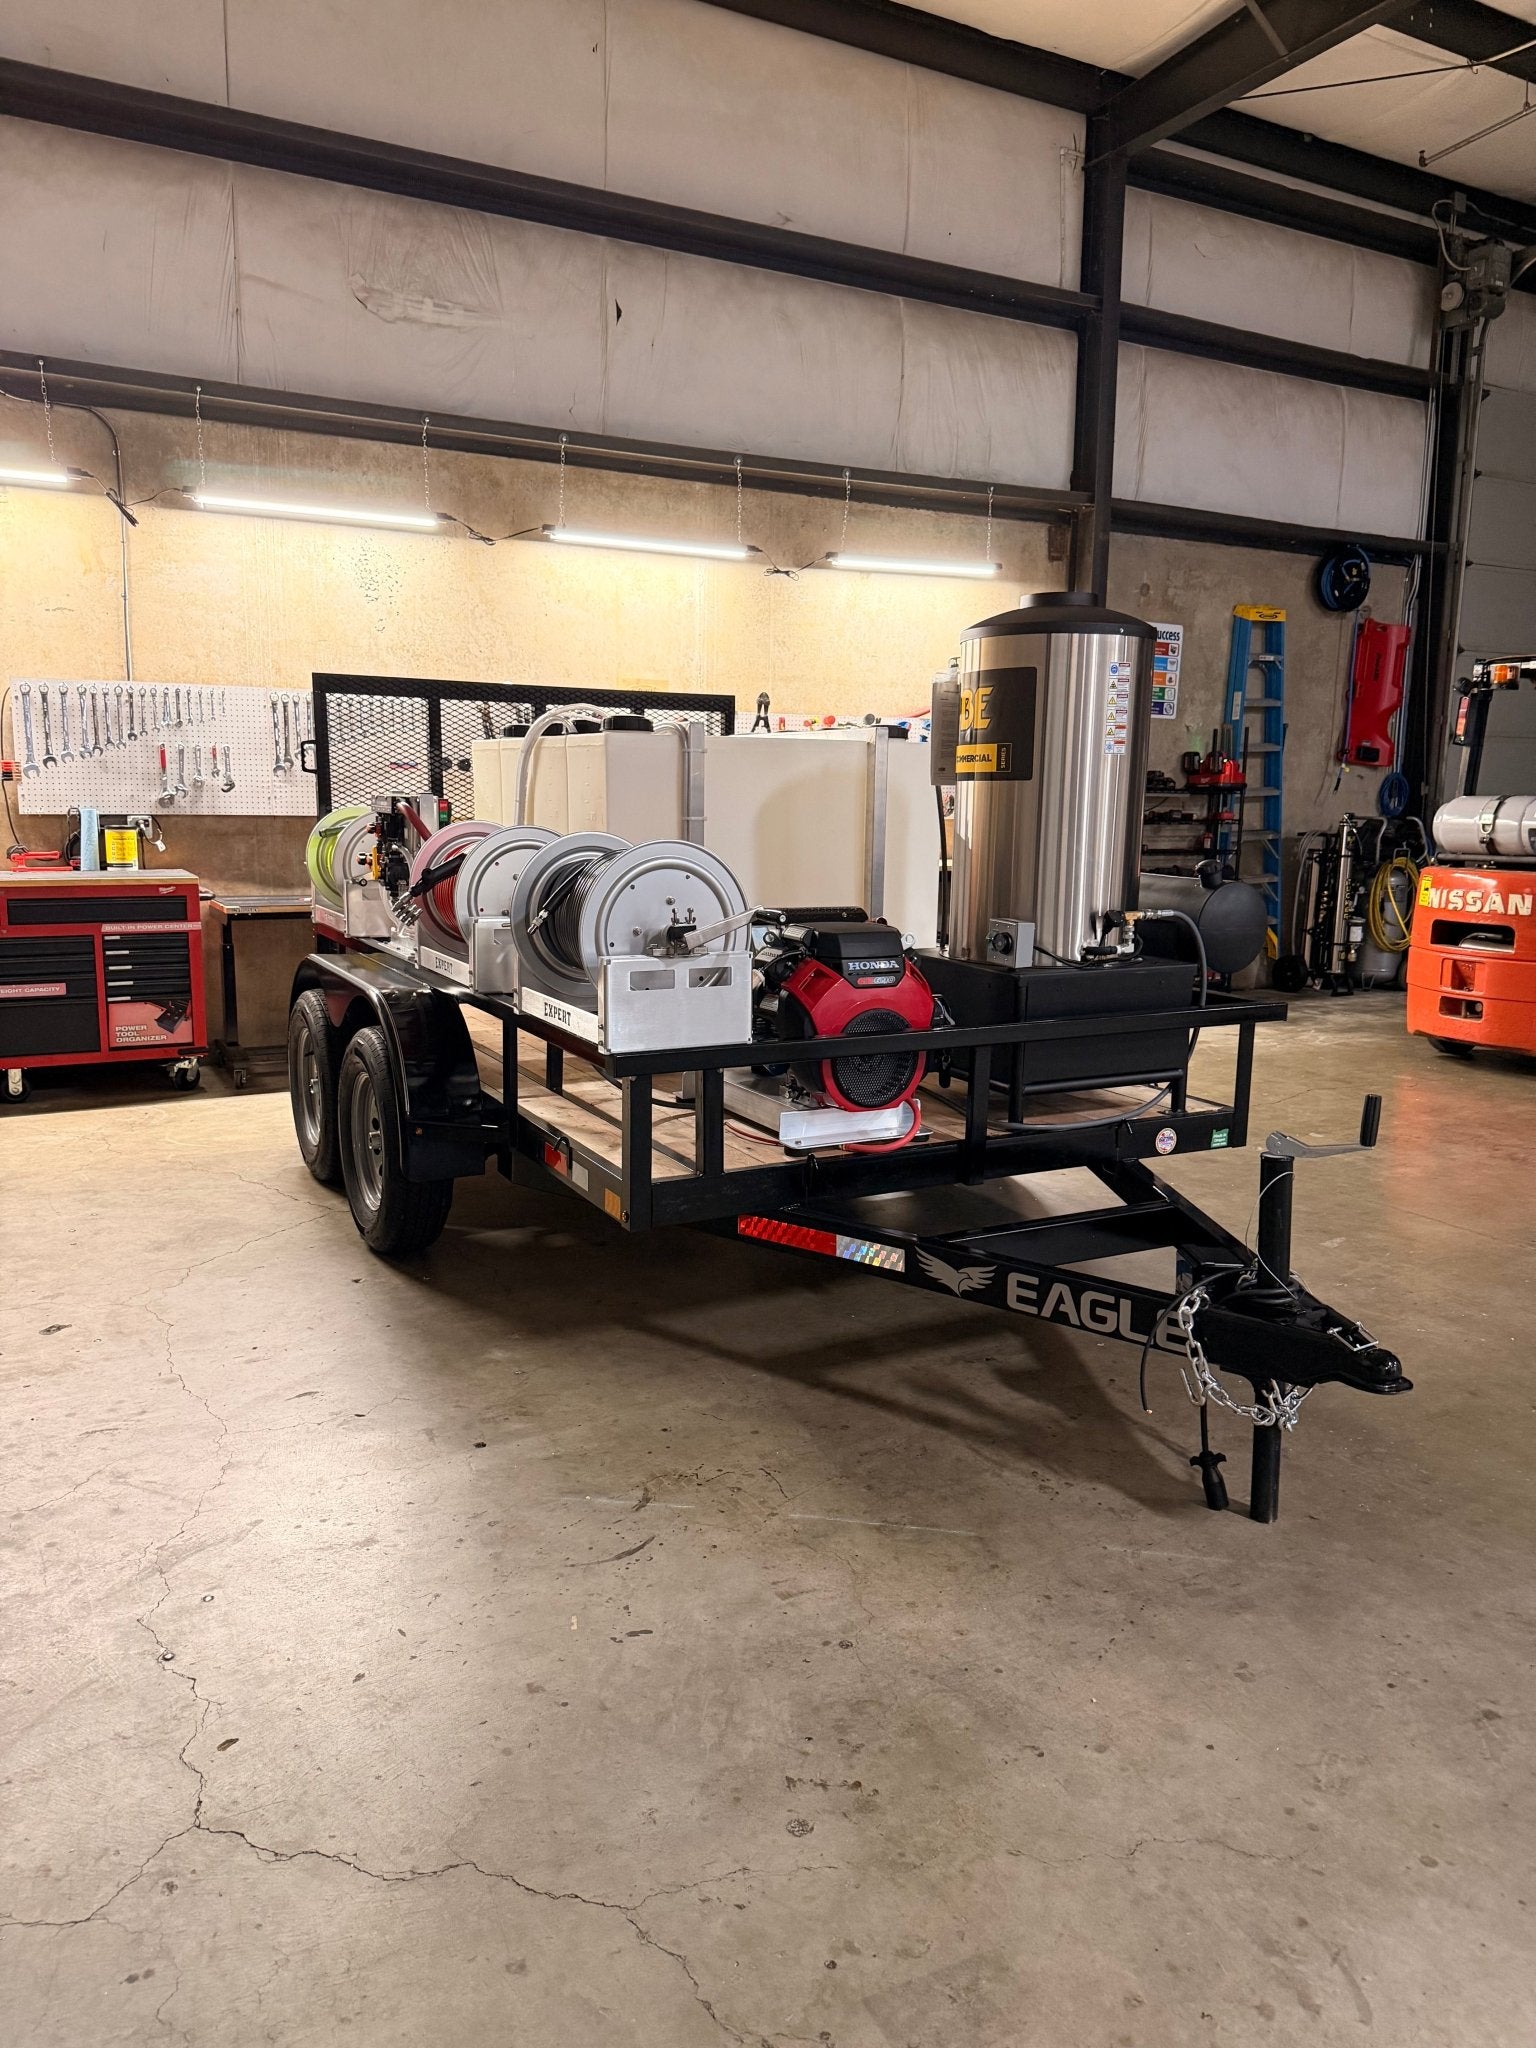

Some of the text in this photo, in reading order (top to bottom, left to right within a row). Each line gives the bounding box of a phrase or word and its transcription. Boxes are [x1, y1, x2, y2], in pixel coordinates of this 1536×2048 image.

[1156, 630, 1181, 642] uccess
[1428, 887, 1533, 917] NISSAN
[435, 956, 453, 975] EXPERT
[847, 960, 900, 971] HONDA
[543, 1001, 571, 1027] EXPERT
[116, 1034, 167, 1043] ORGANIZER
[1006, 1272, 1189, 1353] EAGLE
